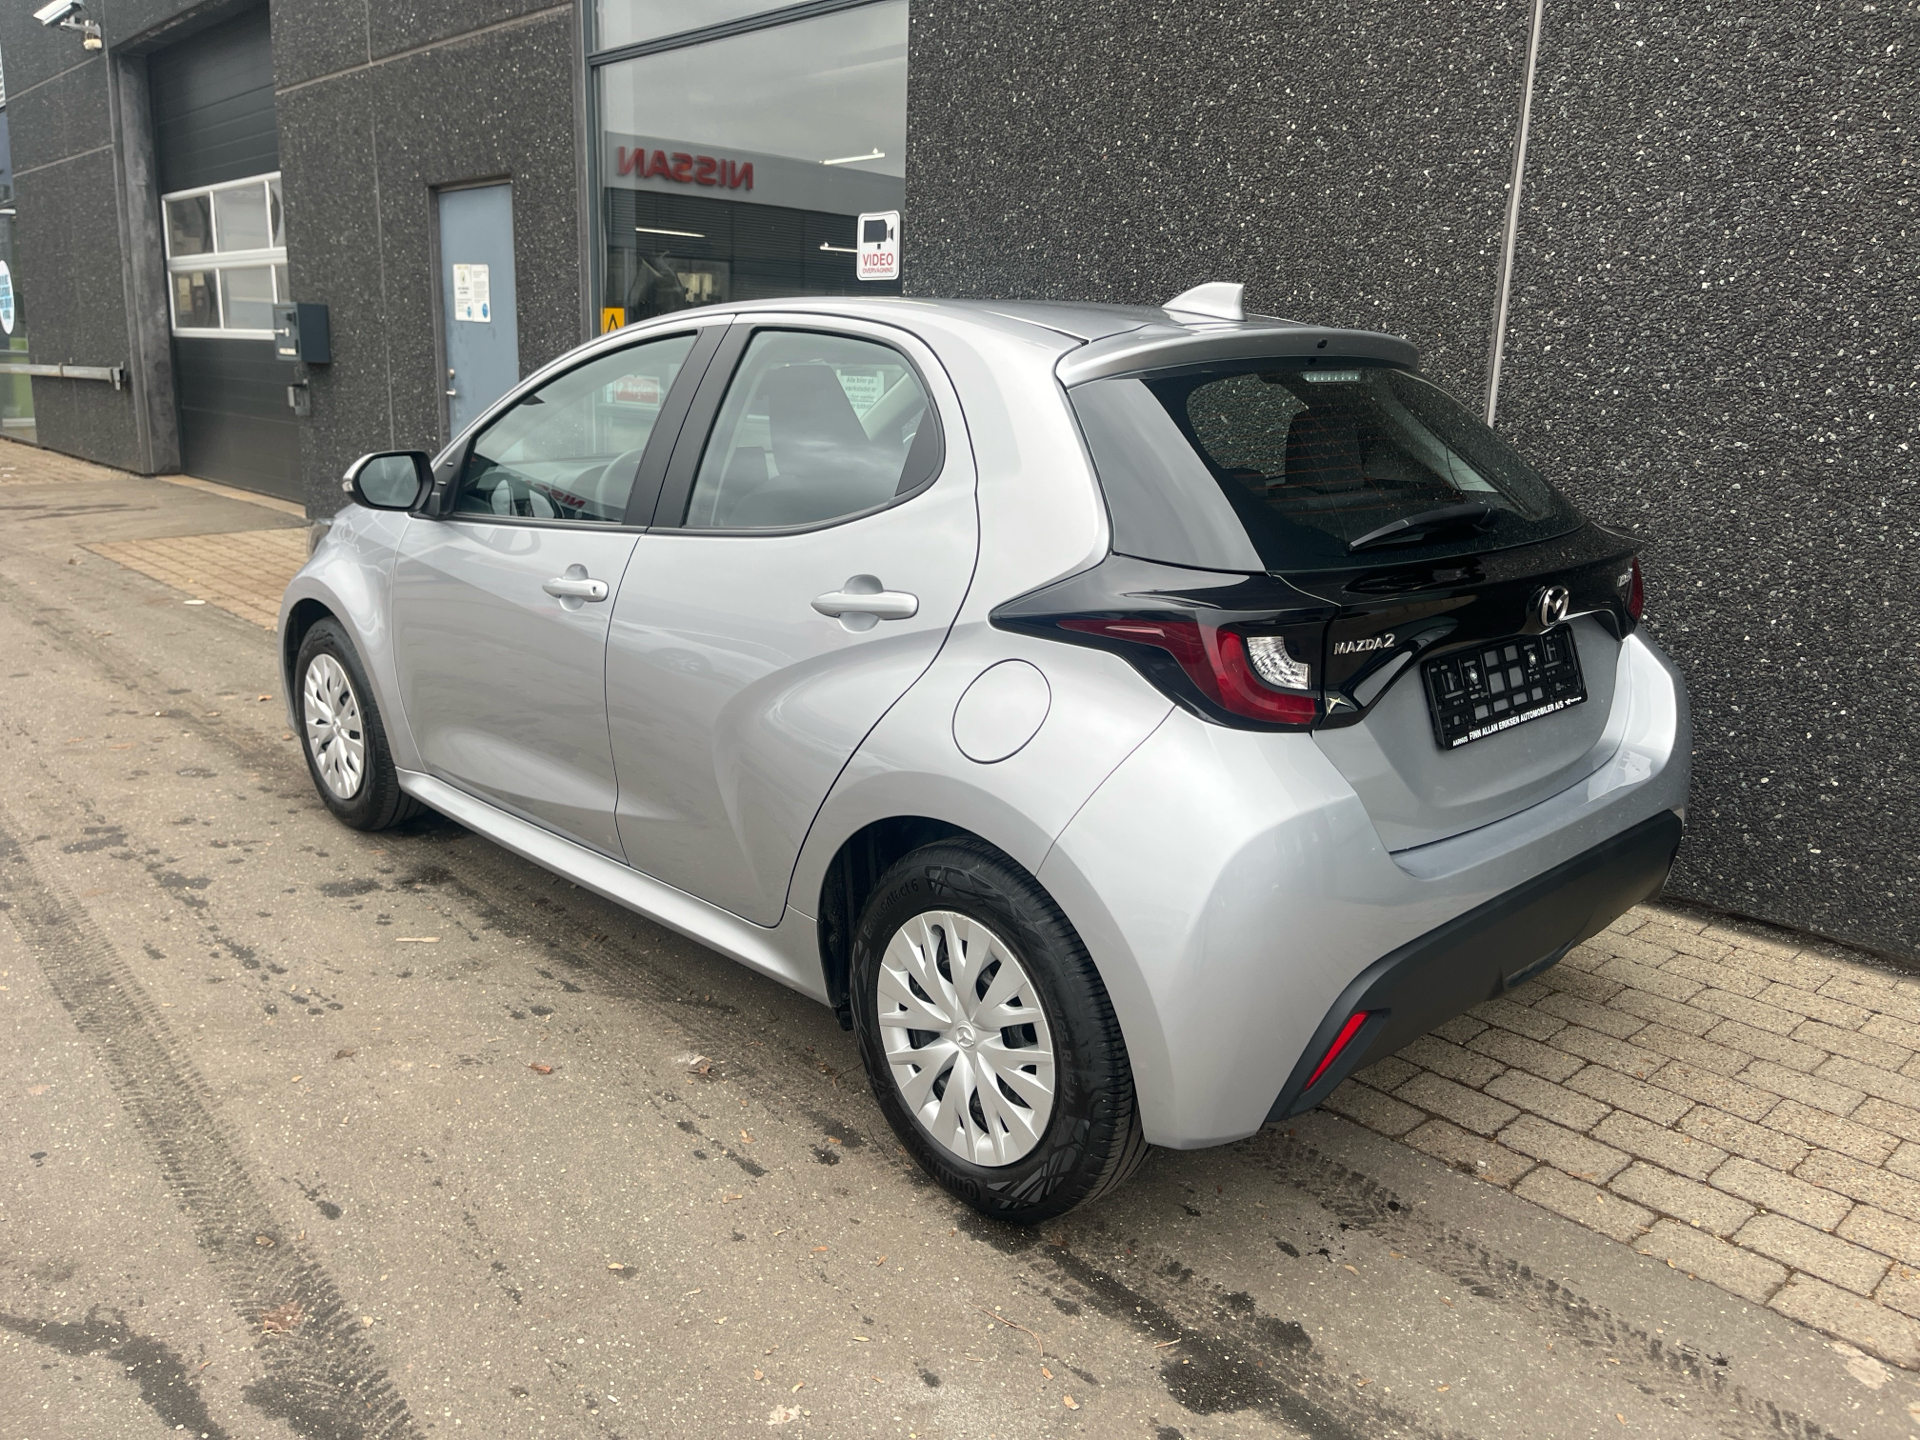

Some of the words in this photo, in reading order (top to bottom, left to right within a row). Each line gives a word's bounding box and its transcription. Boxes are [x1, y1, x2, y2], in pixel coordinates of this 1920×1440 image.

[862, 252, 894, 267] VIDEO
[1333, 633, 1396, 655] MAZDA2
[1469, 729, 1482, 741] FINN
[1482, 722, 1499, 737] ALLAN
[1498, 715, 1520, 730] ERIKSEN
[1520, 703, 1555, 723] AUTOMOBILER
[1555, 700, 1564, 710] A/S
[910, 877, 920, 893] 6
